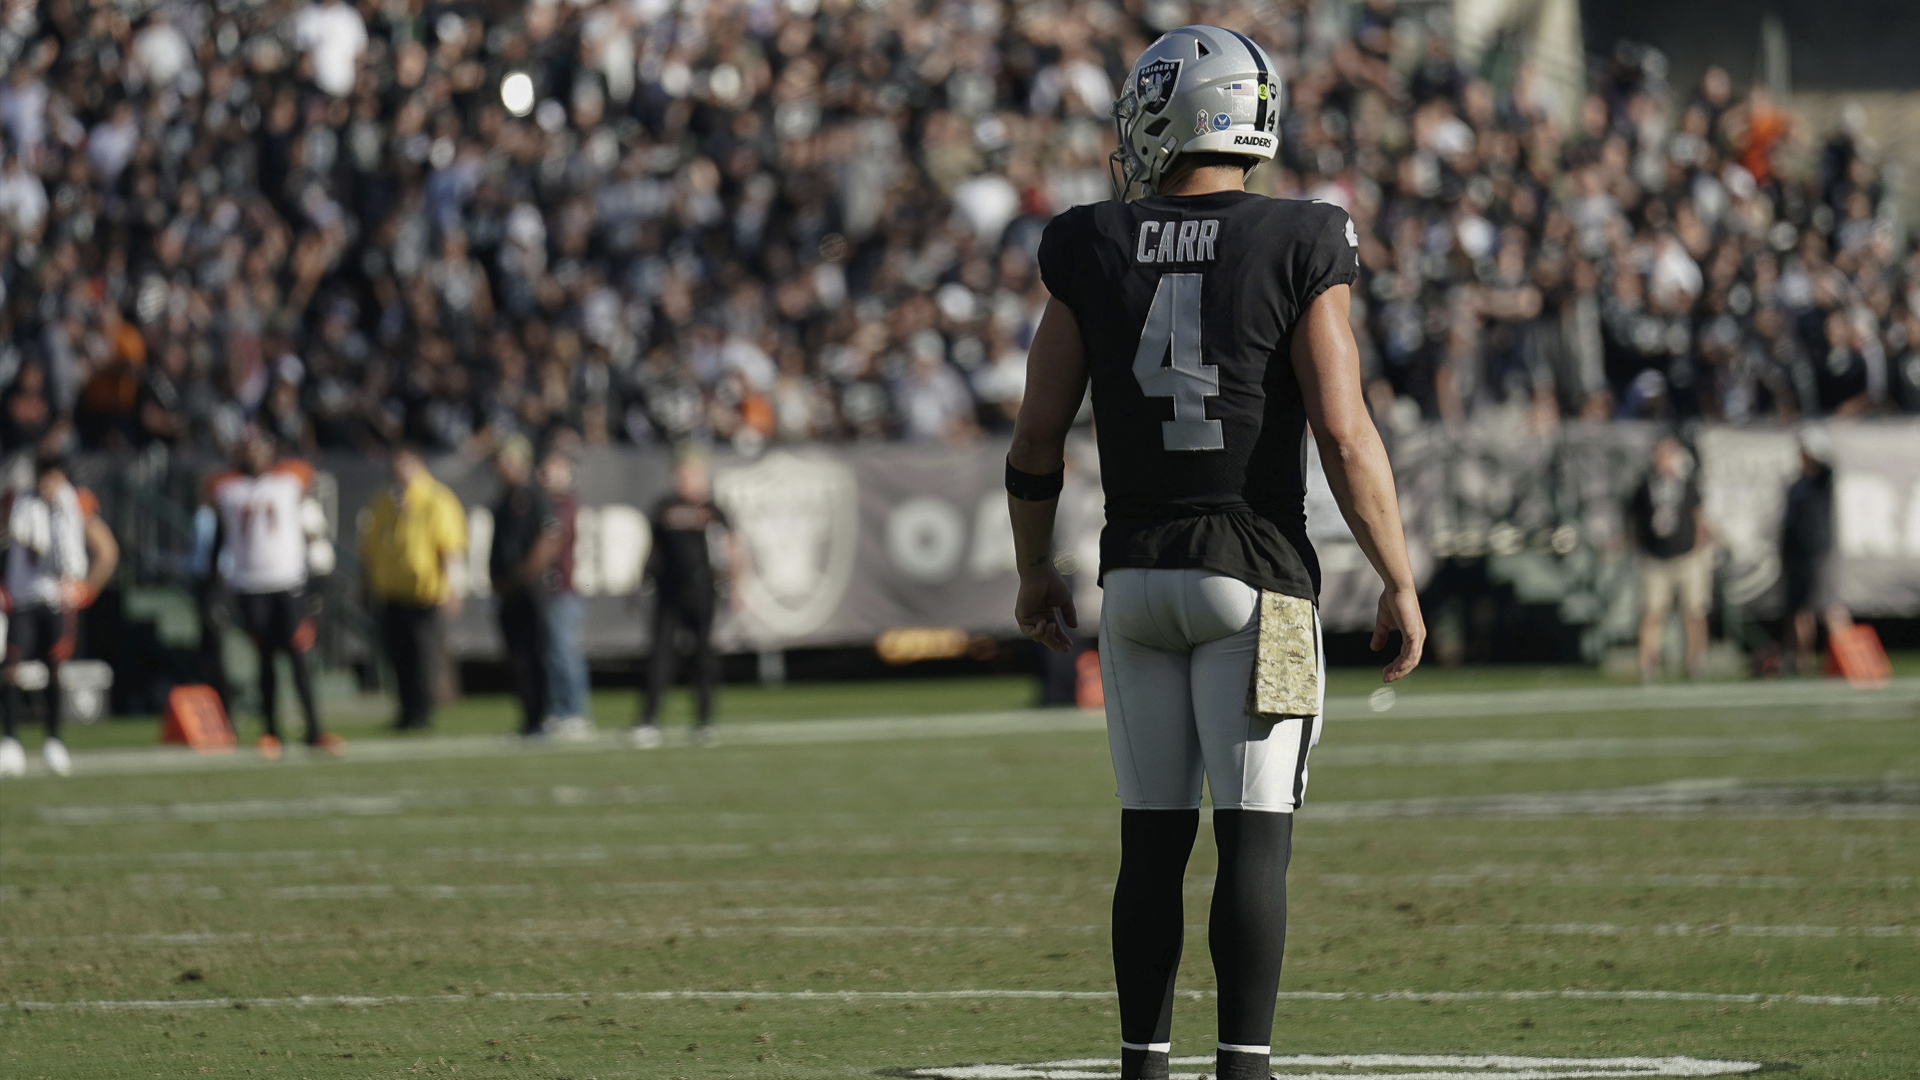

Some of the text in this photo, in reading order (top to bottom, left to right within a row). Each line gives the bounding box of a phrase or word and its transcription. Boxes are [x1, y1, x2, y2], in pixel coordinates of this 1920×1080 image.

[1140, 62, 1176, 75] RAIDERS
[1267, 110, 1276, 132] 4
[1233, 135, 1272, 148] RAIDERS
[1136, 219, 1220, 263] CARR
[1132, 273, 1225, 451] 4
